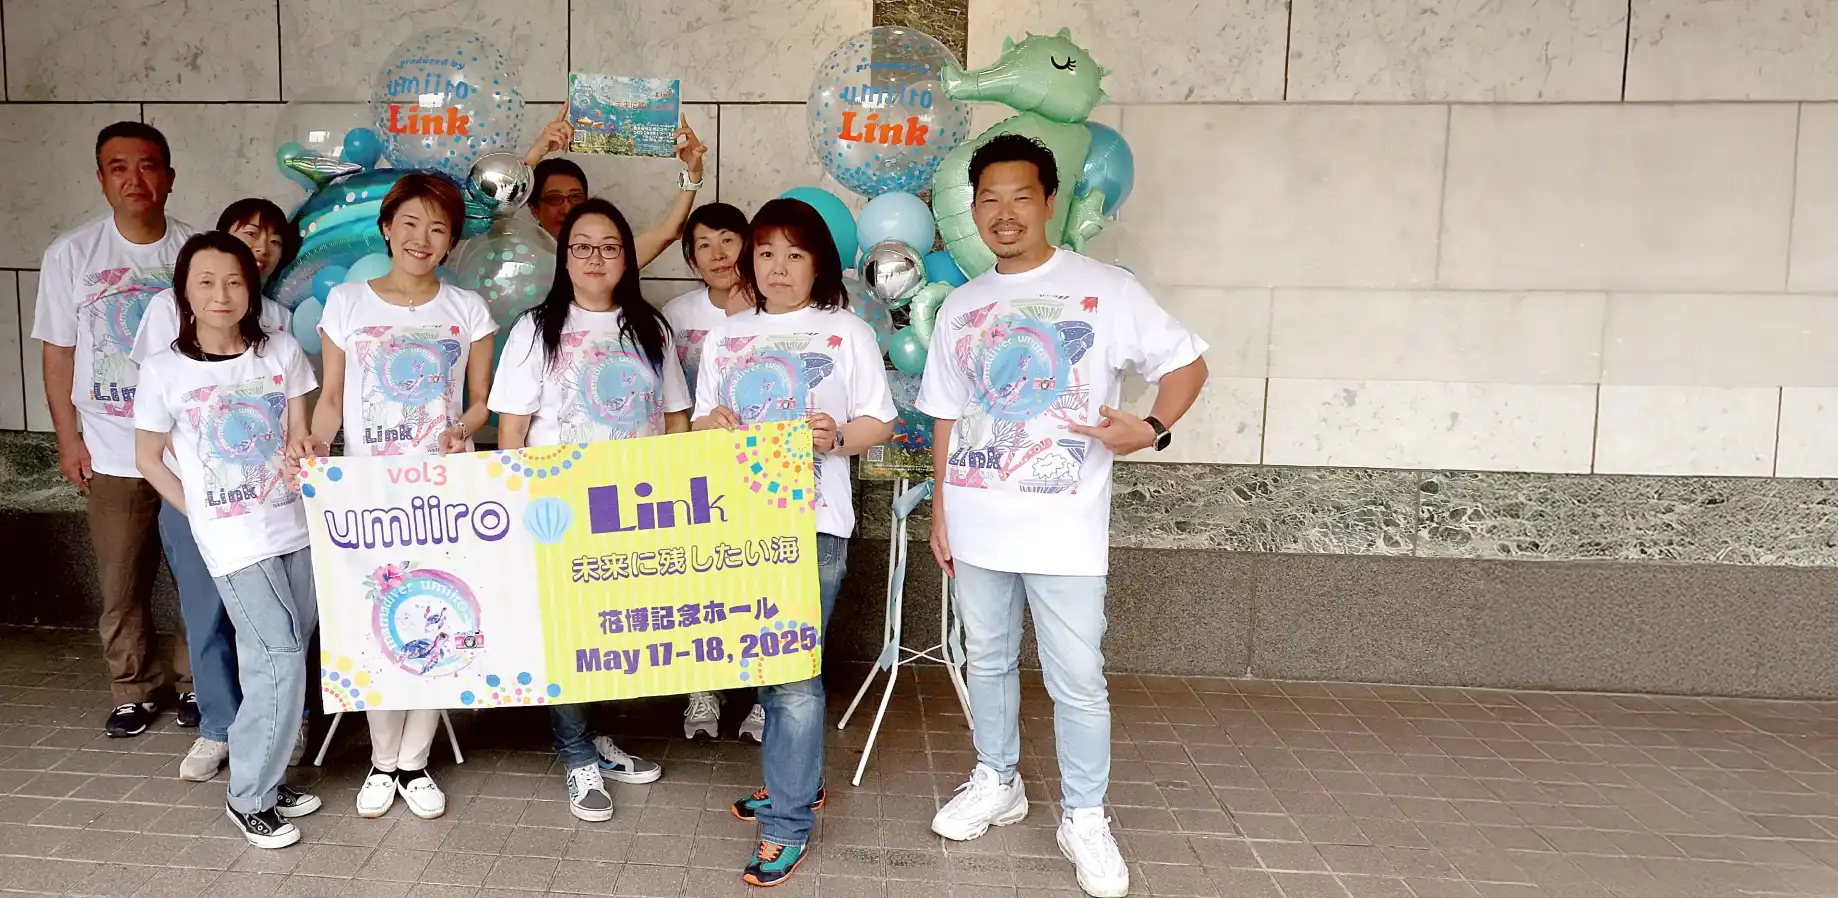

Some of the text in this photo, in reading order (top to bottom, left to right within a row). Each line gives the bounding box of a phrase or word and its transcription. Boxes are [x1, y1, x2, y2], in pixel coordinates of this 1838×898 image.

[387, 72, 469, 100] umiiro
[388, 104, 470, 136] Link
[838, 111, 929, 147] Link
[94, 382, 137, 401] Lin
[365, 424, 413, 443] Link
[387, 461, 447, 486] vol3
[207, 484, 258, 506] Link
[588, 475, 728, 534] Link
[324, 495, 510, 549] umiiro
[571, 536, 800, 583] 未来に残したい海
[597, 597, 780, 635] 花博記念ホール
[575, 626, 818, 675] May 17-18, 2025
